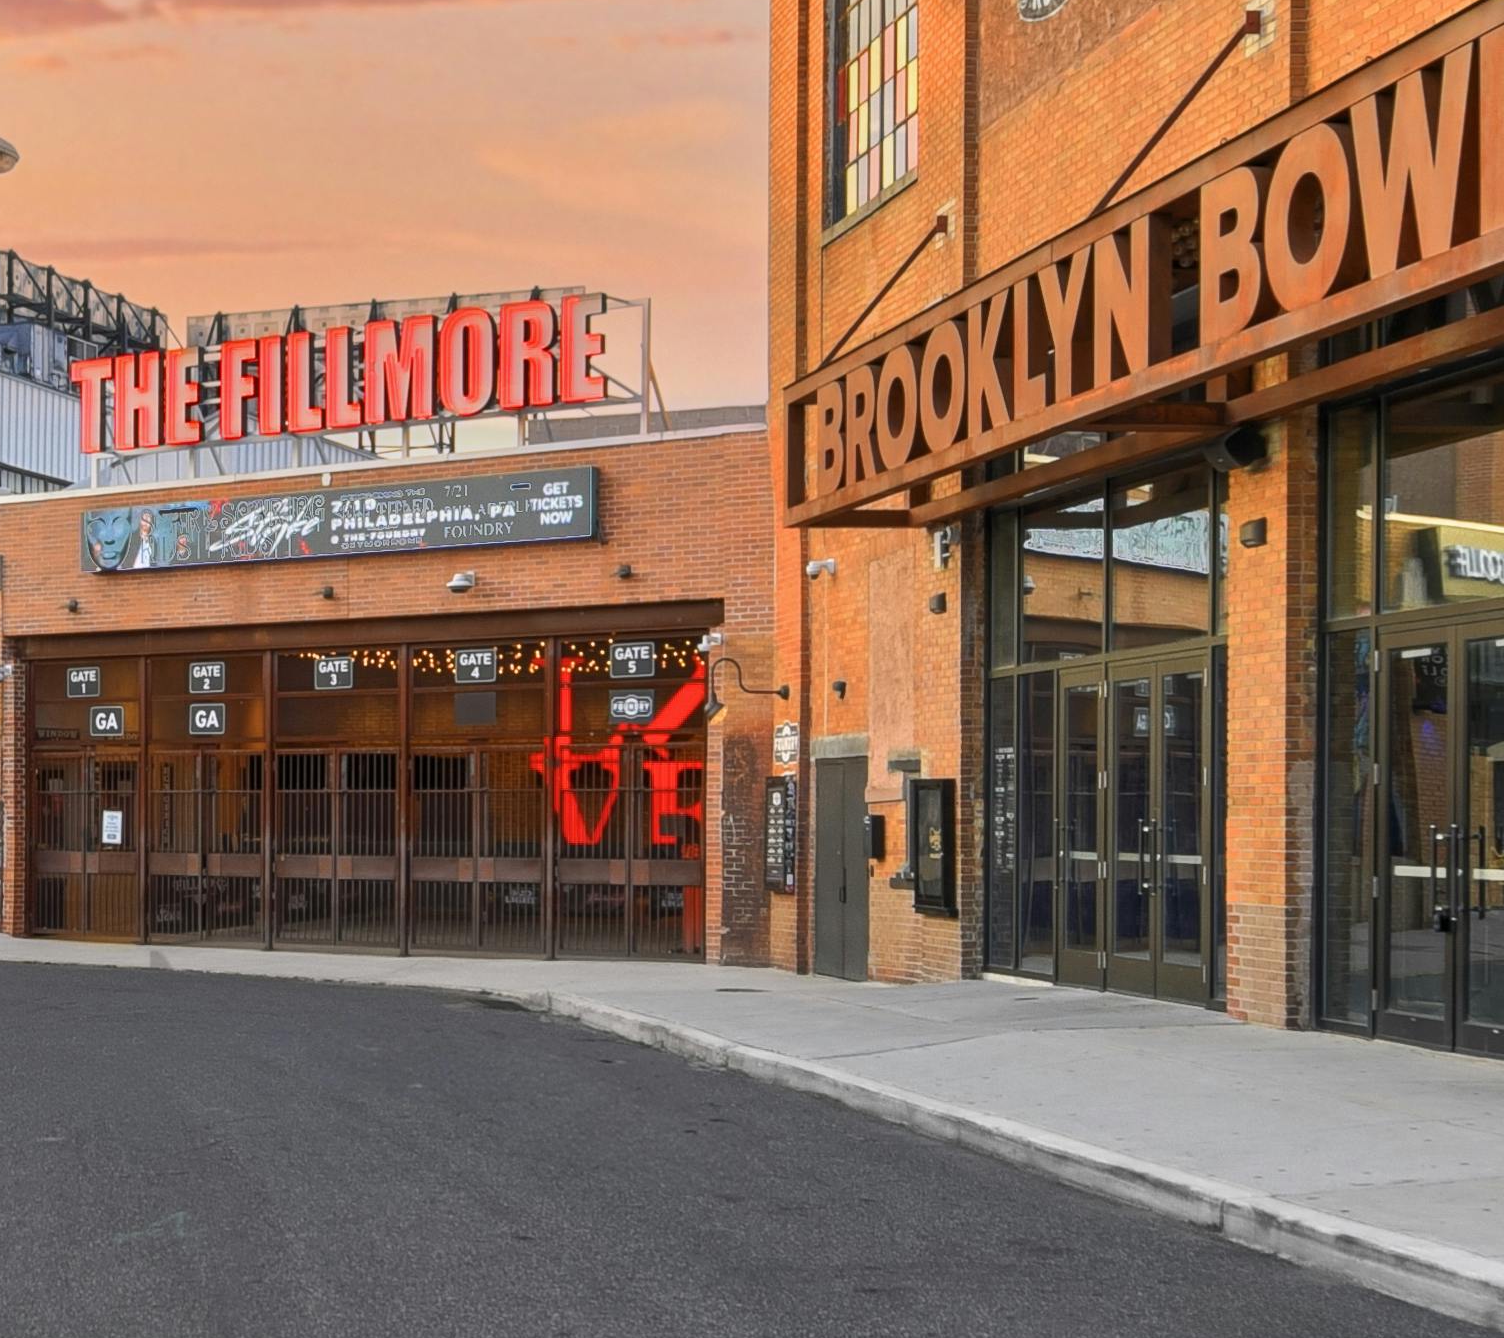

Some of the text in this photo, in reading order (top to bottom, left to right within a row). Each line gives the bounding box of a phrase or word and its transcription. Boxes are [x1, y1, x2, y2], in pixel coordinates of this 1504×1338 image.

[816, 211, 1172, 495] BROOKLYN
[72, 296, 607, 455] THE FILLMORE
[542, 481, 570, 496] GET
[530, 495, 584, 511] TICKETS
[330, 509, 481, 530] PHILADELPHIA,
[490, 506, 516, 518] PA
[539, 509, 573, 526] NOW
[444, 522, 514, 539] FOUNDRY
[459, 653, 492, 667] GATE
[614, 646, 650, 661] GATE
[192, 665, 221, 678] GATE
[318, 660, 349, 674] GATE
[470, 667, 480, 679] 4
[627, 661, 638, 674] 5
[70, 670, 97, 682] GATE
[329, 674, 338, 686] 3
[80, 683, 87, 694] 1
[203, 678, 211, 690] 2
[95, 712, 118, 730] GA
[195, 710, 219, 728] GA
